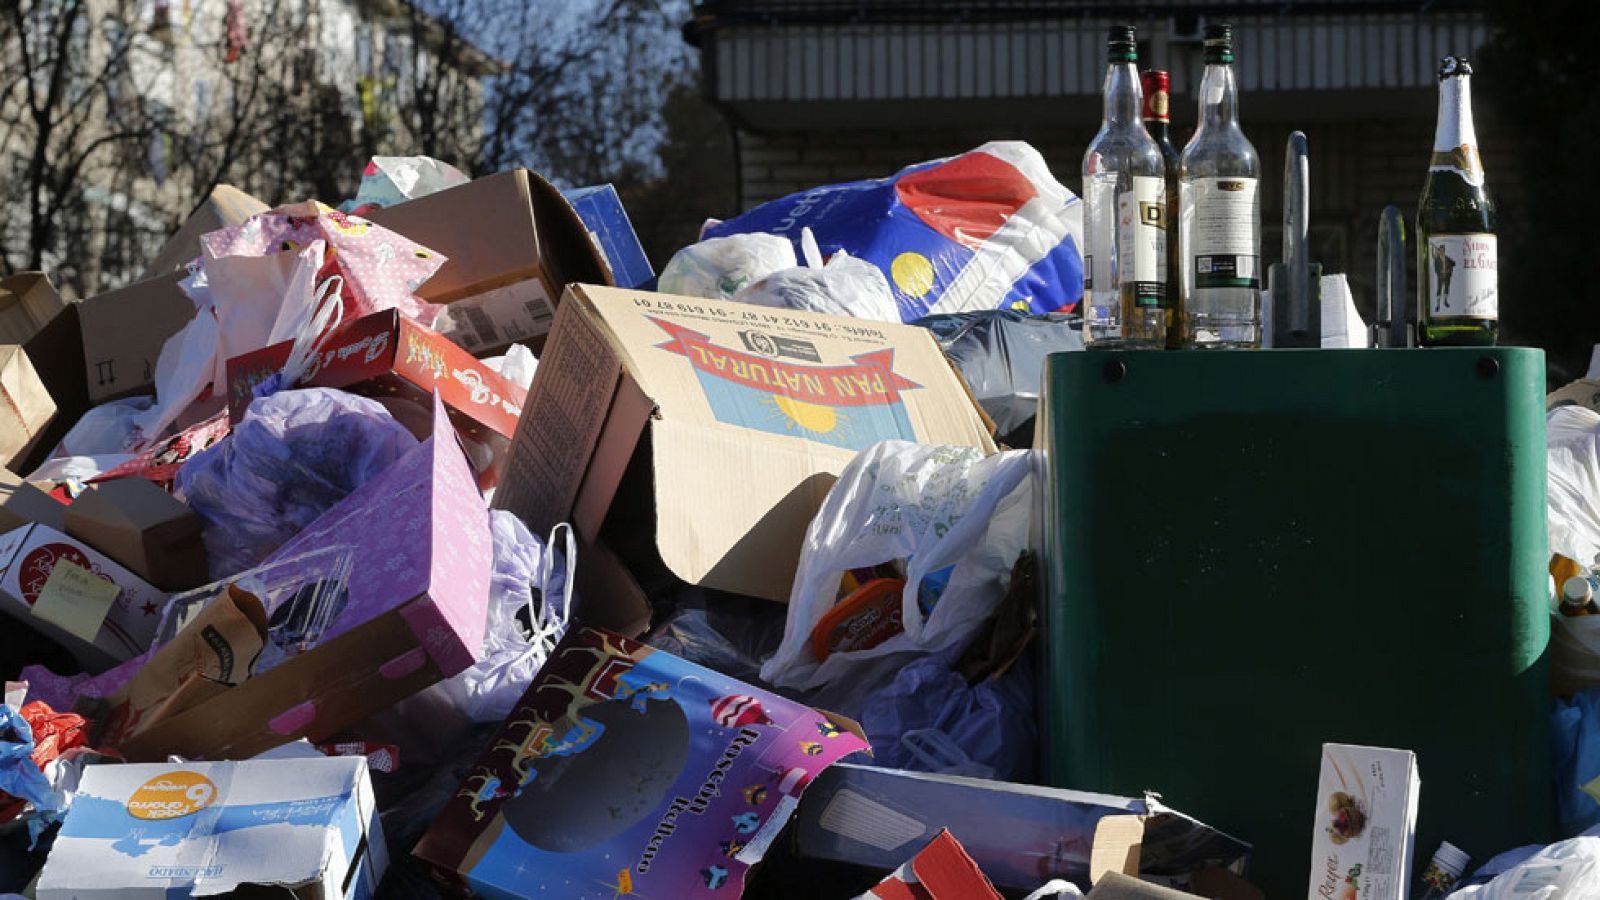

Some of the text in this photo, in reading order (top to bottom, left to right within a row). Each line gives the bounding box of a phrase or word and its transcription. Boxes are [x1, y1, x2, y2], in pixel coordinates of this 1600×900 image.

[710, 307, 727, 317] 91
[760, 314, 778, 325] 41
[783, 317, 810, 329] 612
[814, 320, 831, 332] 91
[690, 344, 823, 396] NATURAL
[830, 371, 887, 398] PAN
[687, 727, 761, 815] Roscón
[186, 783, 212, 808] 6
[130, 800, 182, 811] ahorro
[145, 801, 189, 820] pack
[636, 793, 692, 875] Relleno
